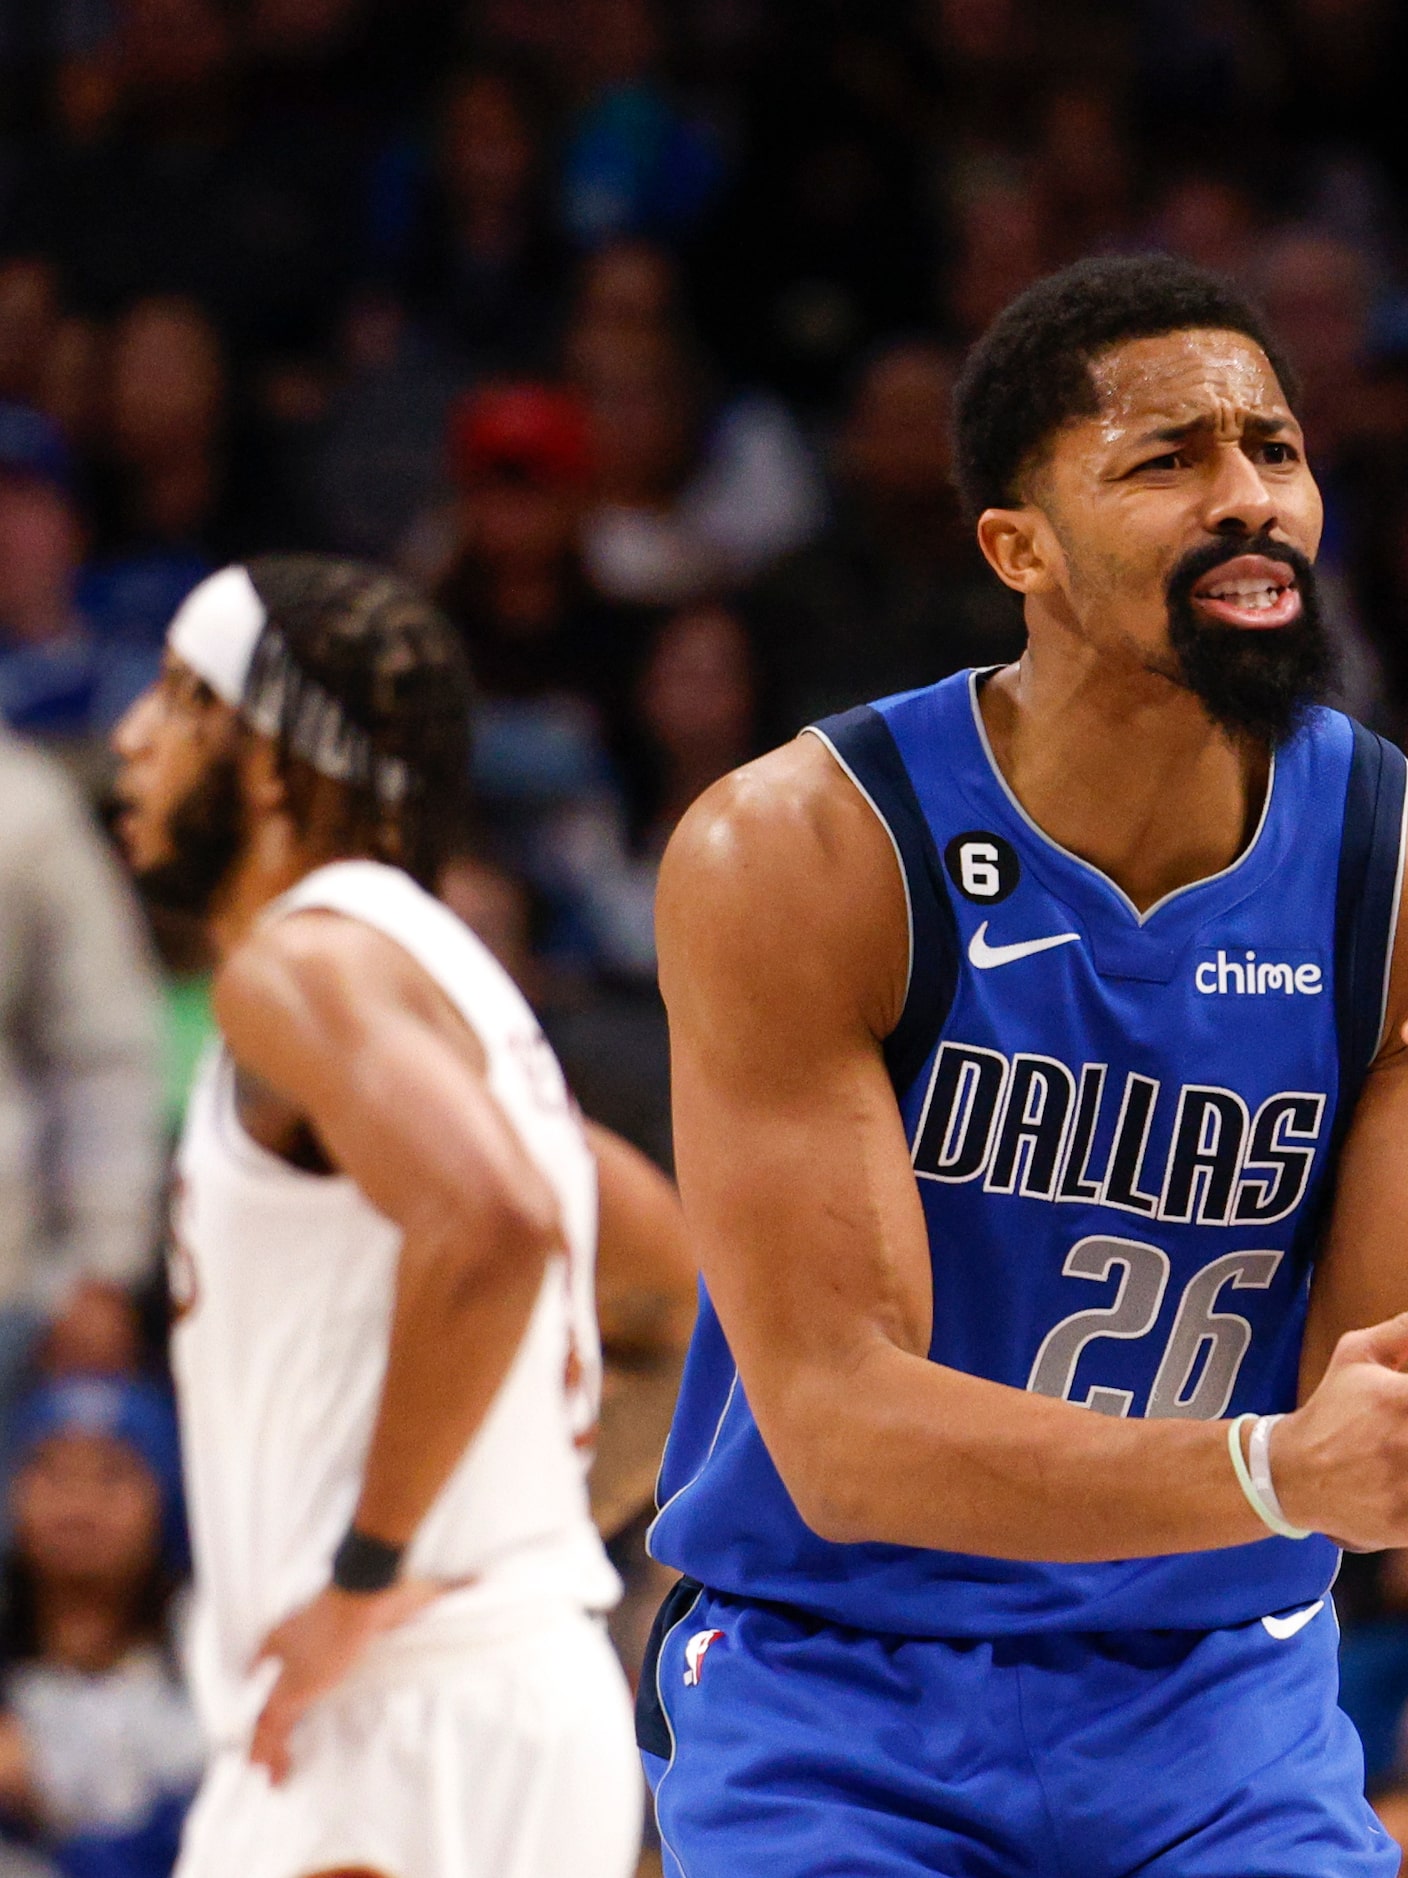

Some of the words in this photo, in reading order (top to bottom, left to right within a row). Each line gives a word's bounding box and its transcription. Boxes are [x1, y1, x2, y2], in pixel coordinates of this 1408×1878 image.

[960, 843, 1000, 897] 6
[1196, 951, 1323, 995] chime
[910, 1040, 1327, 1227] DALLAS
[1026, 1234, 1285, 1421] 26
